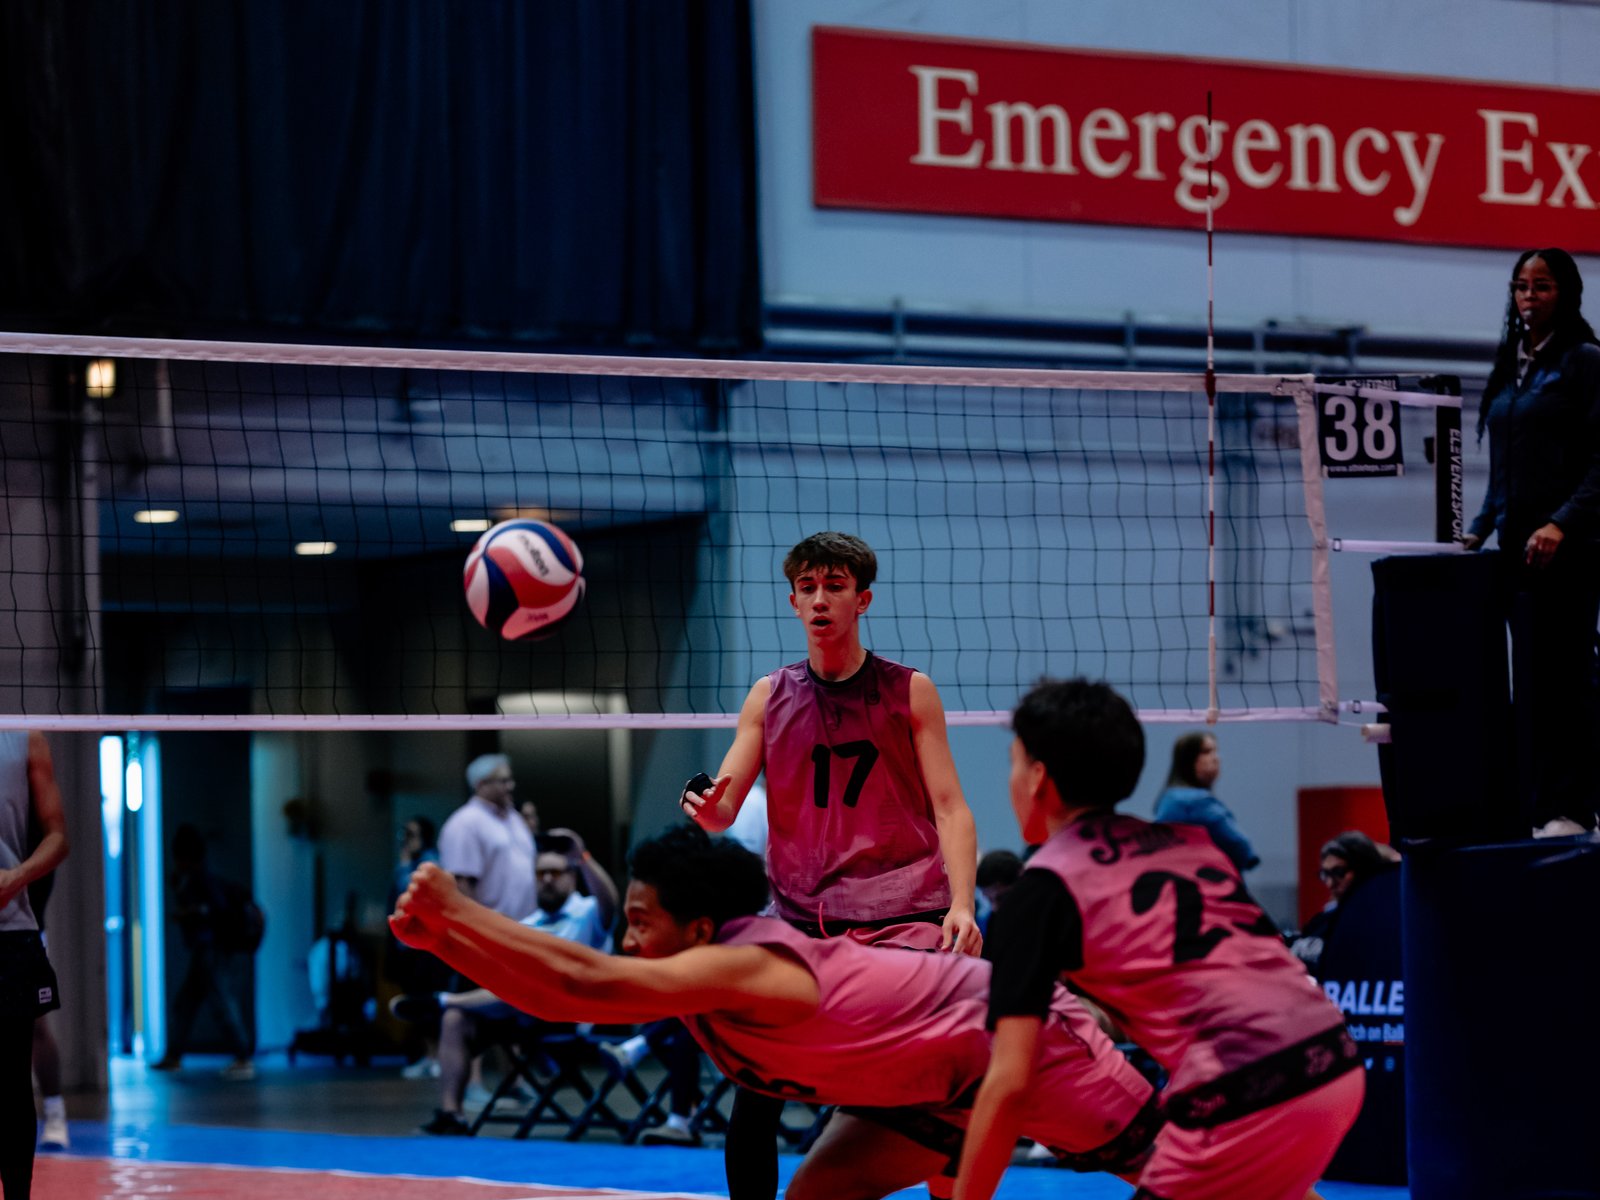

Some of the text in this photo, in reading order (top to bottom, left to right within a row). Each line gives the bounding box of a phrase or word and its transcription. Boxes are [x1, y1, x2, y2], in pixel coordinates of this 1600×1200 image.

[909, 64, 1444, 227] Emergency
[1324, 395, 1397, 462] 38
[811, 739, 879, 809] 17
